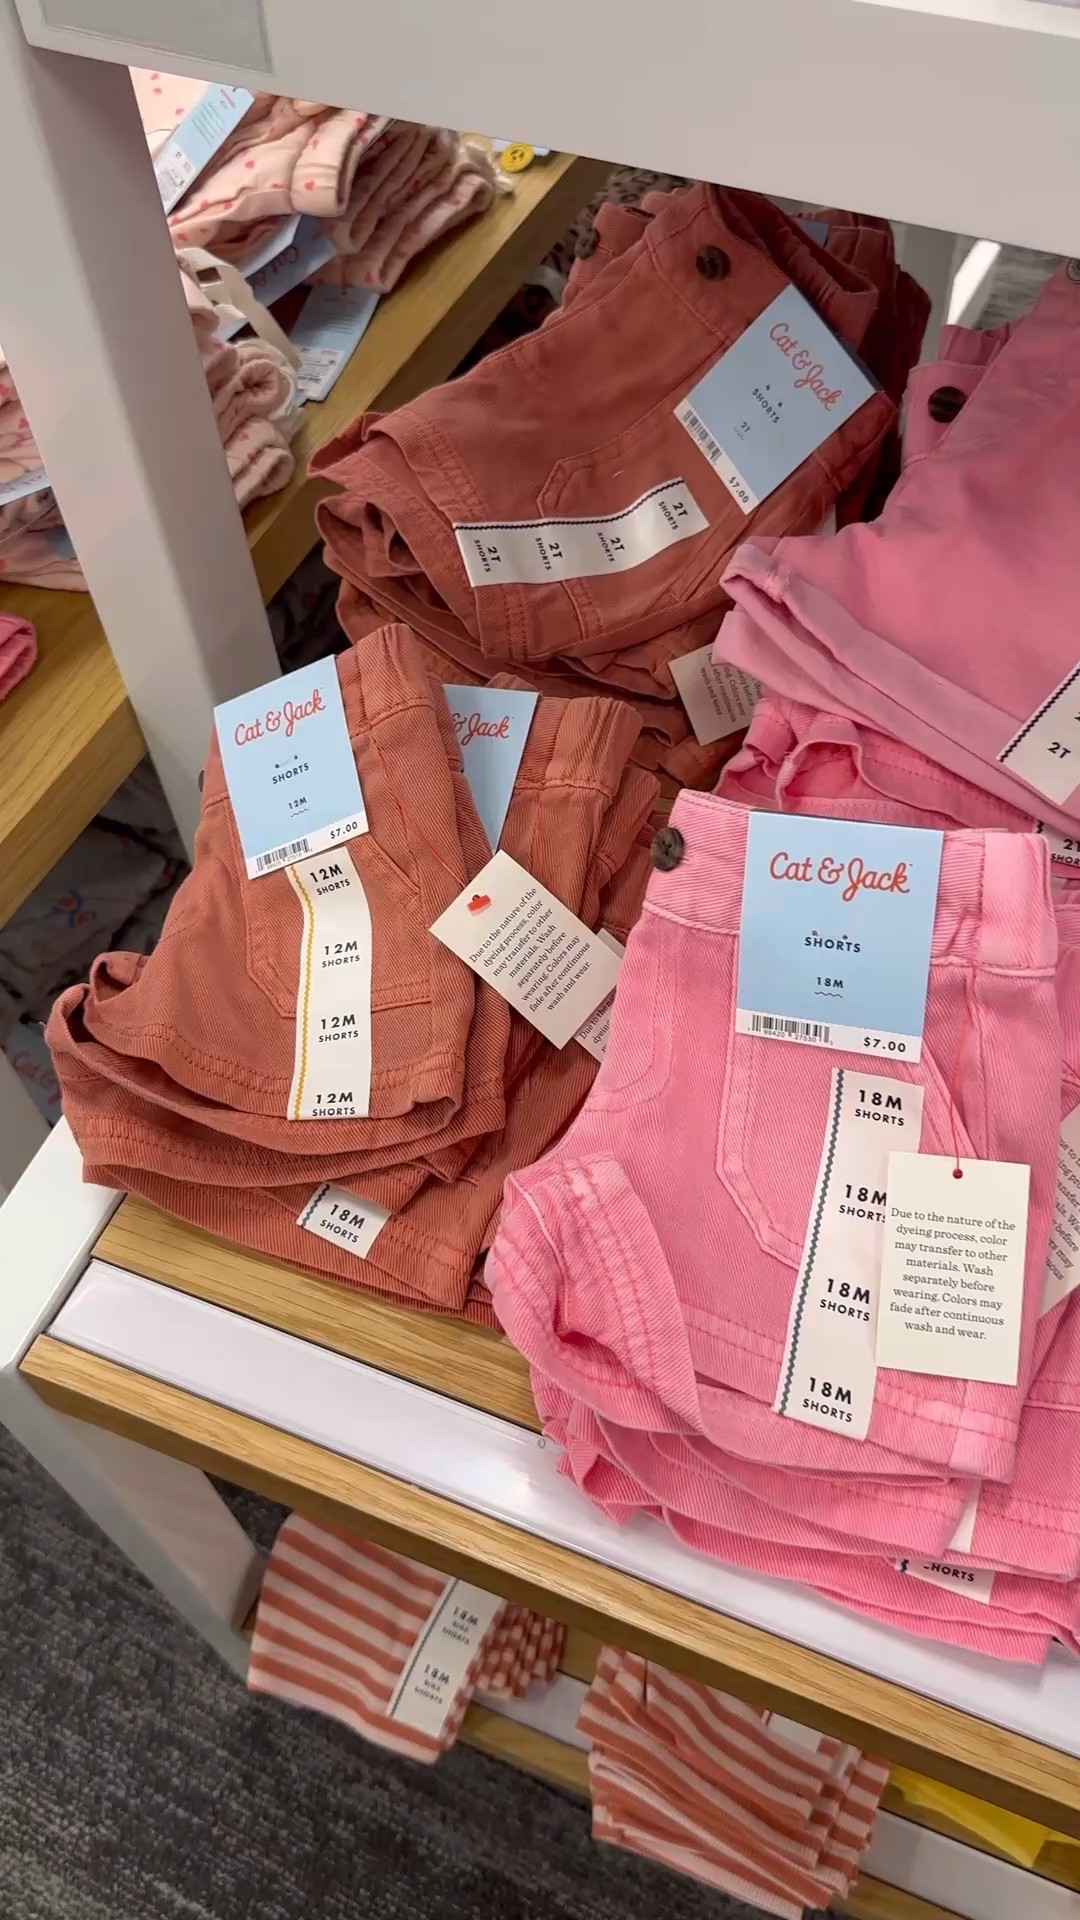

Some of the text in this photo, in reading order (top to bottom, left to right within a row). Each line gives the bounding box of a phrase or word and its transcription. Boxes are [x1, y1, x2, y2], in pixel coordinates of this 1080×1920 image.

[769, 322, 842, 412] Cat & Jack
[752, 388, 780, 424] SHORTS
[740, 421, 751, 433] 2T
[728, 475, 750, 504] $7.00
[658, 501, 680, 531] SHORTS
[672, 502, 689, 518] 2T
[474, 539, 491, 573] SHORTS
[487, 546, 501, 563] 2T
[535, 537, 552, 571] SHORTS
[549, 542, 563, 560] 2T
[596, 531, 615, 563] SHORTS
[610, 537, 626, 553] 2T
[235, 688, 326, 746] Cat & Jack
[461, 712, 510, 746] Jack
[1047, 741, 1071, 759] 2T
[272, 762, 310, 785] SHORTS
[288, 796, 307, 810] 12M
[330, 821, 358, 839] $7.00
[1051, 853, 1080, 865] SHOR
[309, 863, 343, 884] 12M
[769, 851, 911, 902] Cat & Jack
[316, 878, 351, 896] SHORTS
[469, 887, 537, 963] Due to the nature of the
[483, 899, 543, 968] dyeing process, color
[324, 940, 358, 956] 12M
[493, 908, 553, 977] may transfer to other
[508, 924, 556, 978] materials. Wash
[804, 935, 861, 953] SHORTS
[322, 954, 361, 968] SHORTS
[517, 932, 567, 988] separately before
[522, 935, 580, 1002] wearing. Colors may
[529, 942, 591, 1012] fade after continuous
[547, 961, 592, 1011] wash and wear.
[816, 976, 844, 989] 18M
[320, 1014, 356, 1030] 12M
[579, 1025, 593, 1040] Due
[590, 1017, 599, 1026] to
[596, 1005, 607, 1018] the
[318, 1030, 359, 1043] SHORTS
[863, 1036, 906, 1053] $7.00
[316, 1091, 353, 1105] 12M
[858, 1089, 903, 1111] 18M
[312, 1106, 356, 1117] SHORTS
[854, 1108, 905, 1127] SHORTS
[1067, 1149, 1077, 1159] to
[846, 1184, 887, 1207] 18M
[330, 1204, 365, 1229] 18M
[891, 1207, 1016, 1231] Due to the nature of the
[320, 1219, 359, 1243] SHORTS
[896, 1224, 1008, 1246] dyeing process, color
[1055, 1223, 1079, 1252] before
[894, 1241, 1008, 1262] may transfer to other
[1056, 1250, 1074, 1268] may
[906, 1258, 994, 1276] materials. Wash
[825, 1278, 871, 1305] 18M
[902, 1273, 995, 1292] separately before
[819, 1298, 871, 1322] SHORTS
[893, 1288, 1003, 1311] wearing. Colors may
[890, 1302, 1005, 1326] fade after continuous
[904, 1320, 987, 1340] wash and wear.
[808, 1376, 853, 1405] 18M
[802, 1398, 853, 1424] SHORTS
[923, 1563, 975, 1582] HORTS
[452, 1606, 480, 1626] 18M
[423, 1664, 450, 1684] 18M
